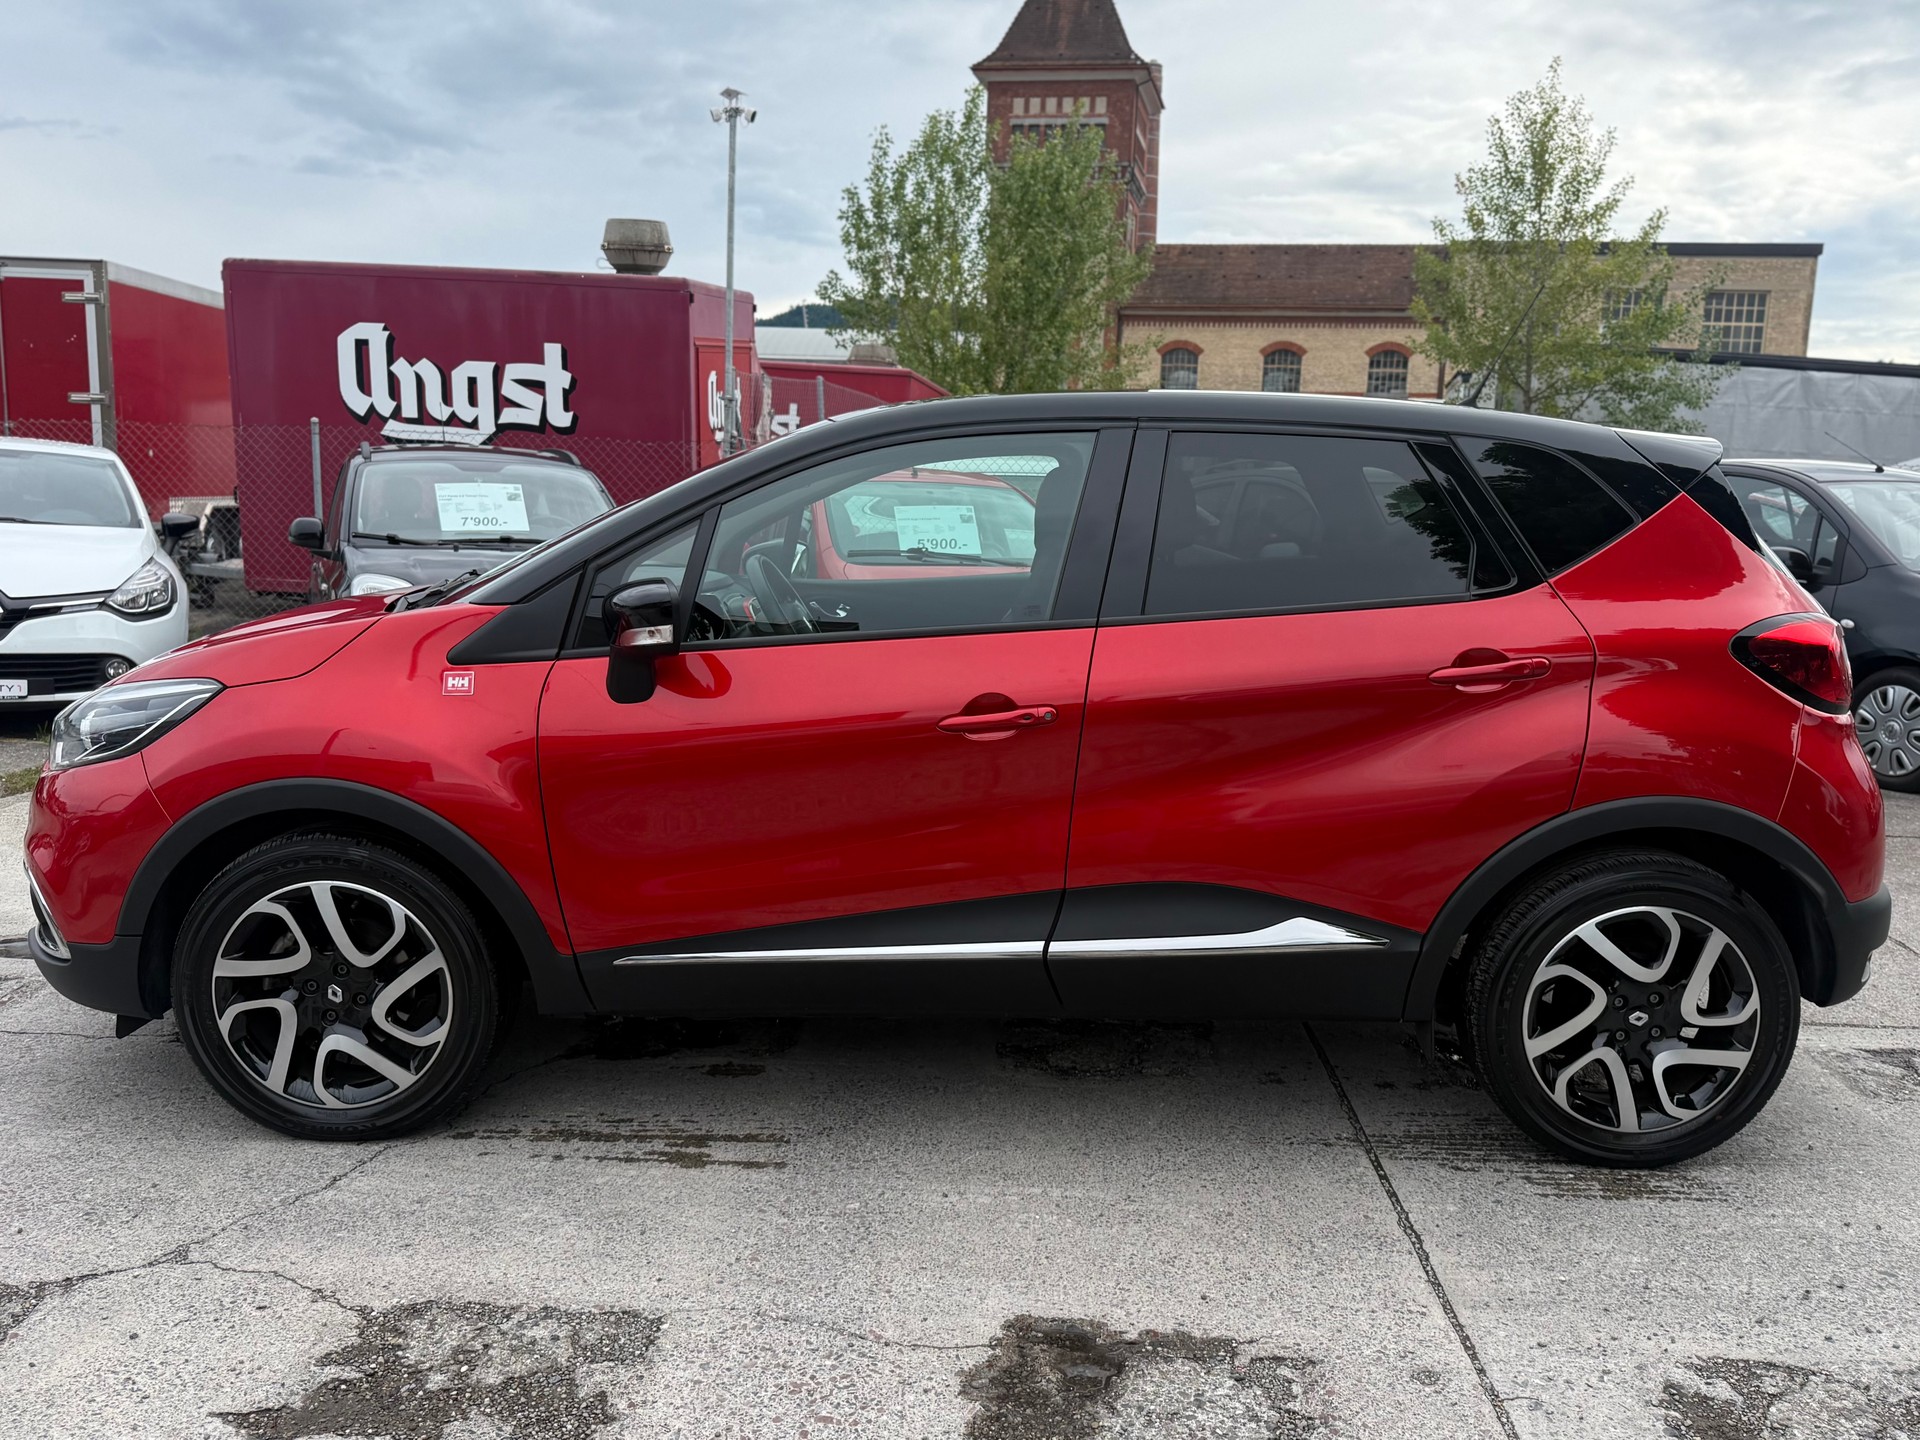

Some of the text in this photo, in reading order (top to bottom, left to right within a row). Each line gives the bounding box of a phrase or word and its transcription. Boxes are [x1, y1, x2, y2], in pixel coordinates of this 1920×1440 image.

[337, 322, 576, 446] Angst
[461, 516, 508, 527] 7'900.-
[917, 538, 968, 550] 5'900.-
[448, 676, 468, 687] HH
